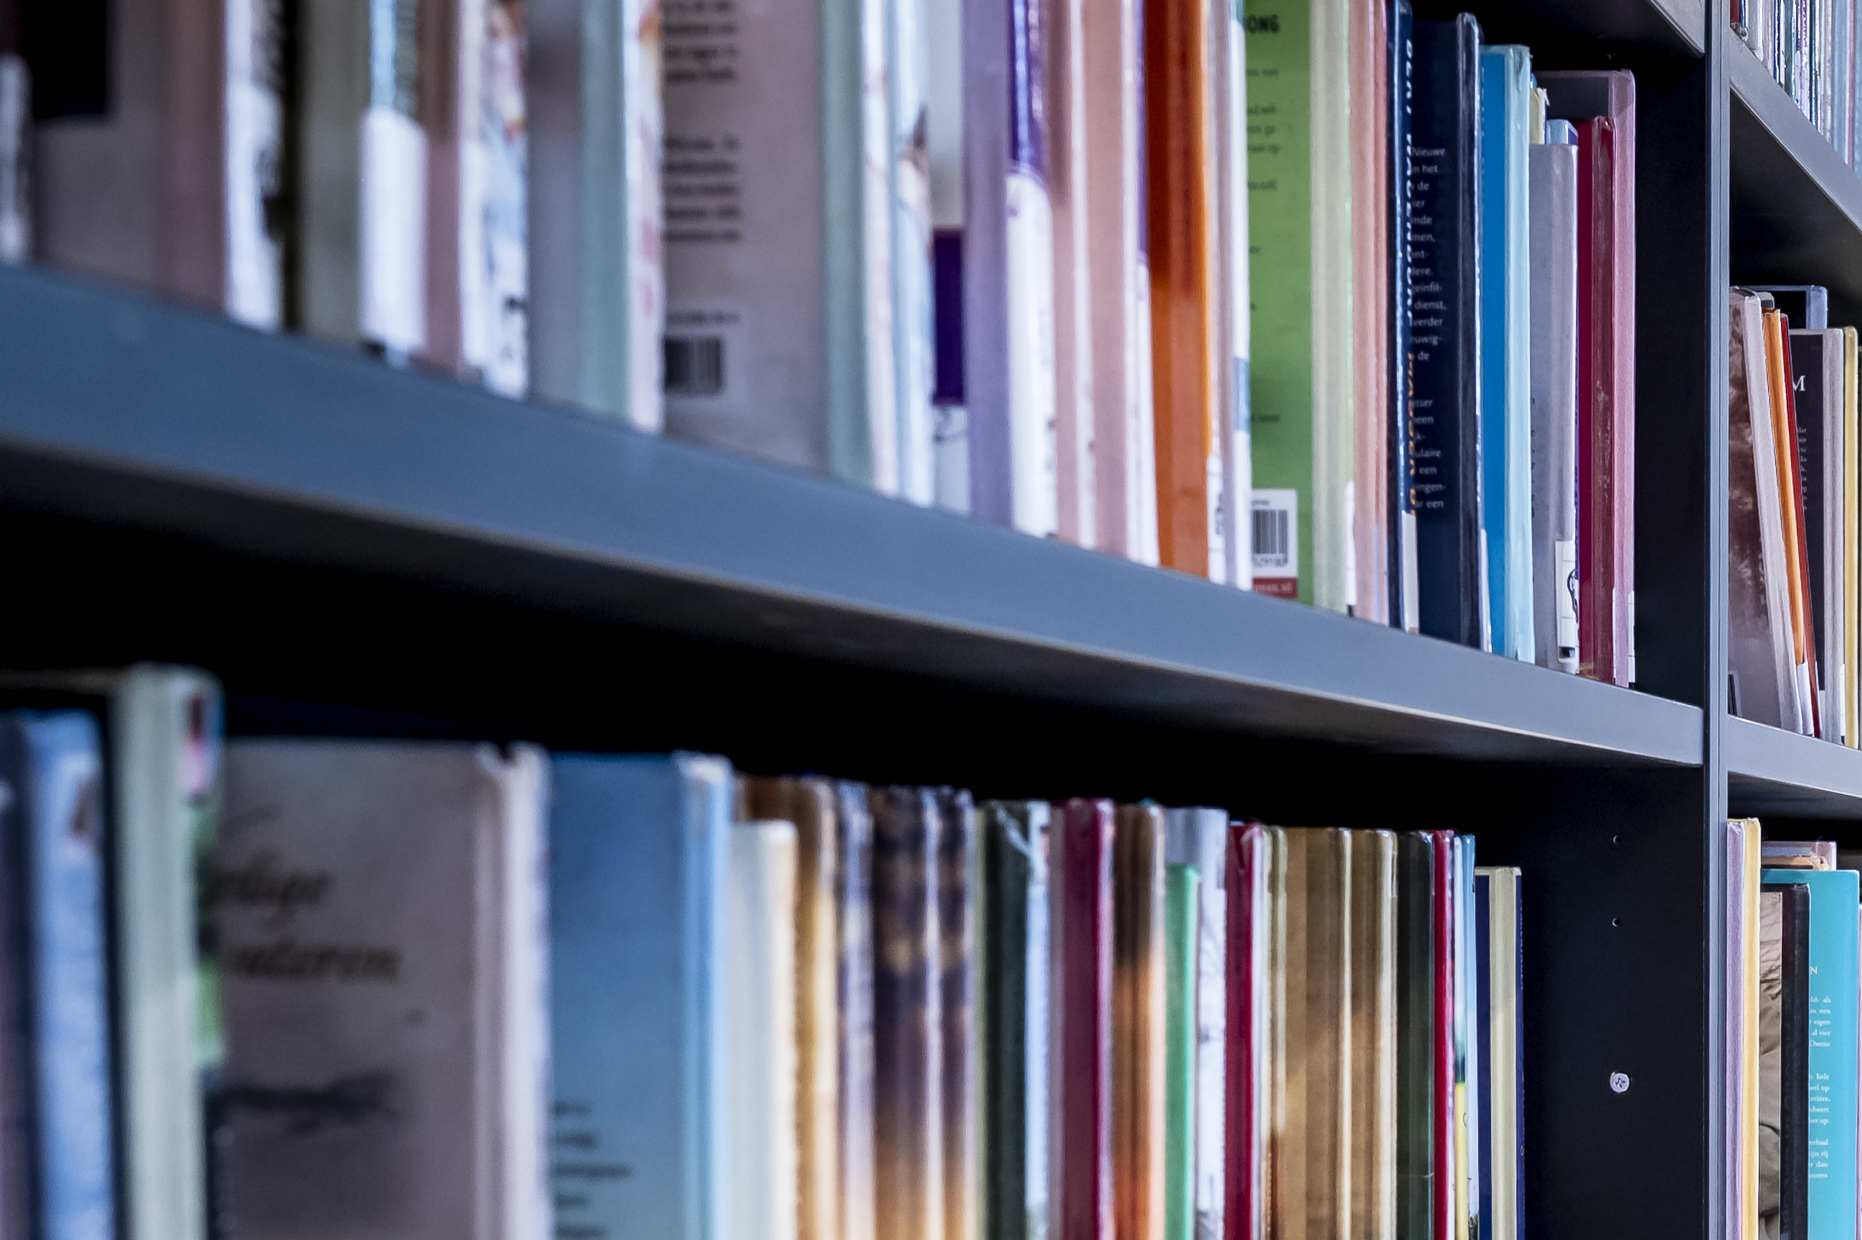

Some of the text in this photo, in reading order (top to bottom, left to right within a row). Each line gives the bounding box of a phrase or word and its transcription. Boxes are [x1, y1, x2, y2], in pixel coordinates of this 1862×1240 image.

[1422, 164, 1438, 173] het
[1417, 182, 1429, 191] de
[1414, 301, 1447, 310] dienst,
[1417, 351, 1429, 360] de
[1426, 500, 1444, 508] een
[1813, 1019, 1831, 1027] eigen
